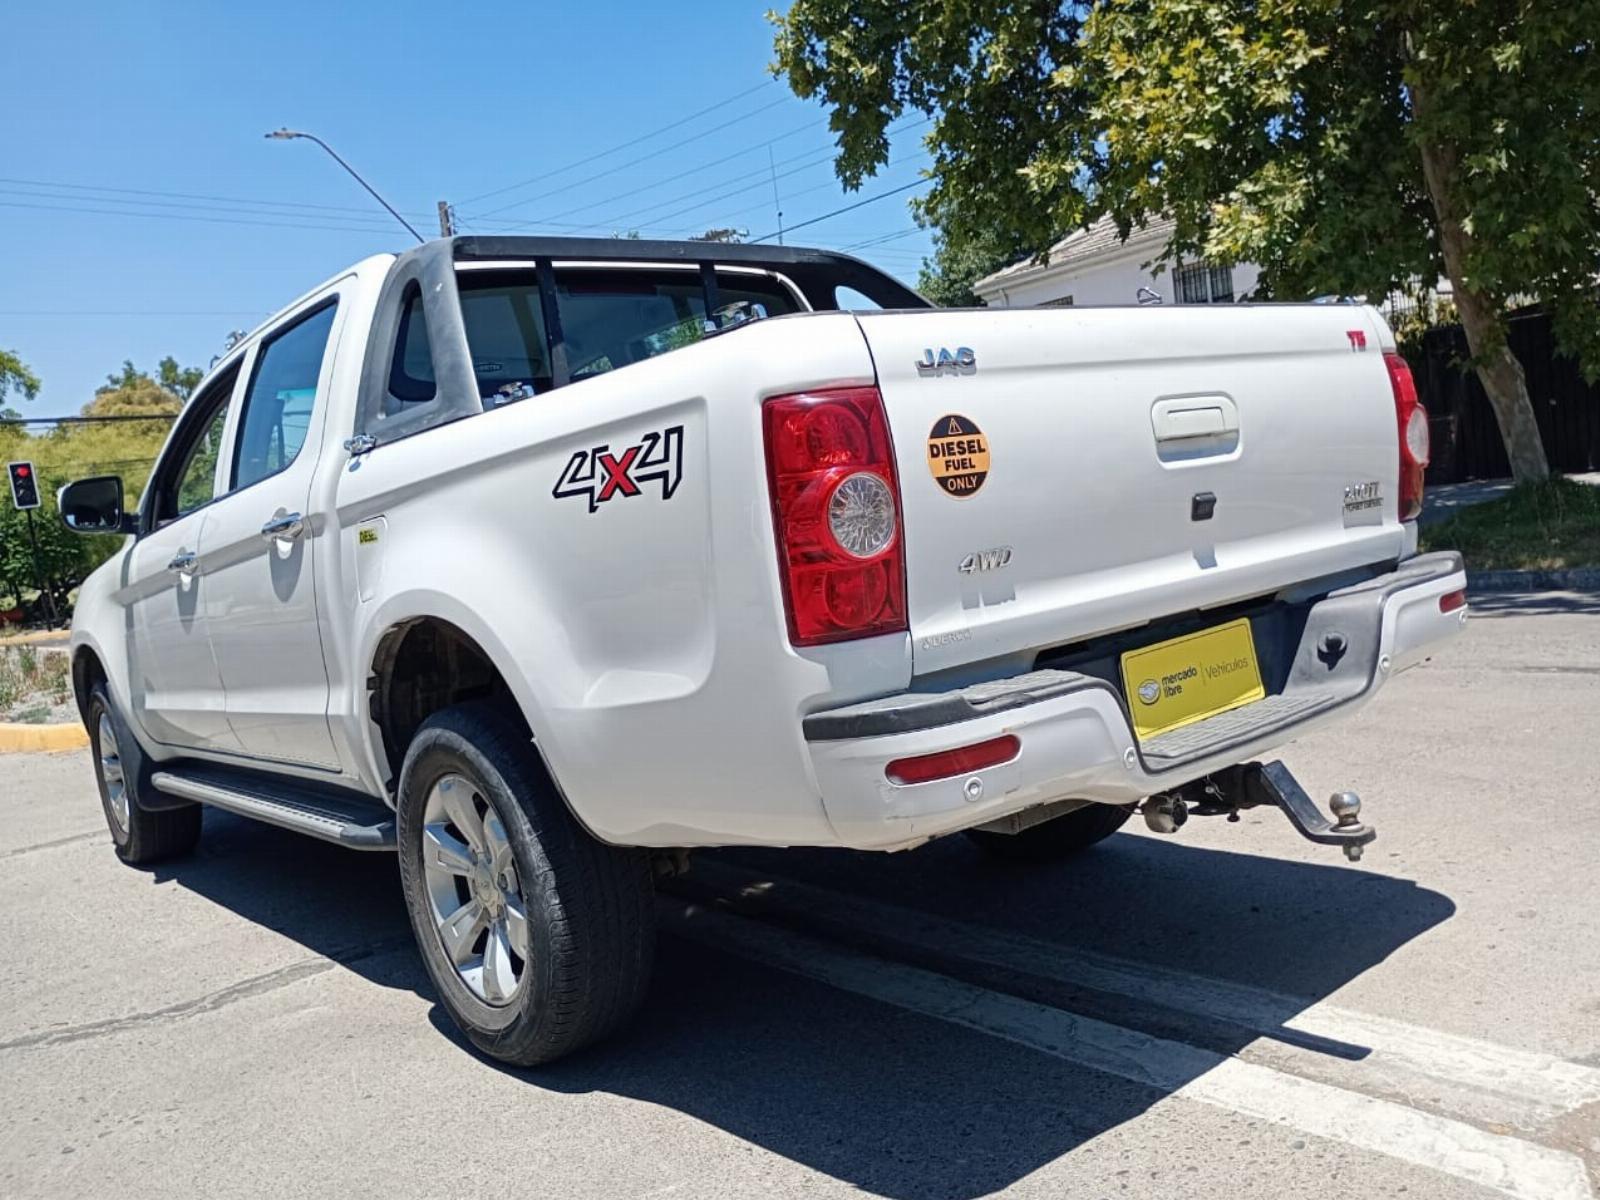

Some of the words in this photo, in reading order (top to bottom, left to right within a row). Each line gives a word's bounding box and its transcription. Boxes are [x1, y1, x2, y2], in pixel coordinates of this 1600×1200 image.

[915, 346, 976, 373] JAC
[929, 439, 986, 459] DIESEL
[945, 457, 976, 472] FUEL
[947, 475, 978, 491] ONLY
[958, 547, 1013, 574] 4WD
[1161, 666, 1198, 685] mercado
[1164, 683, 1182, 698] libre
